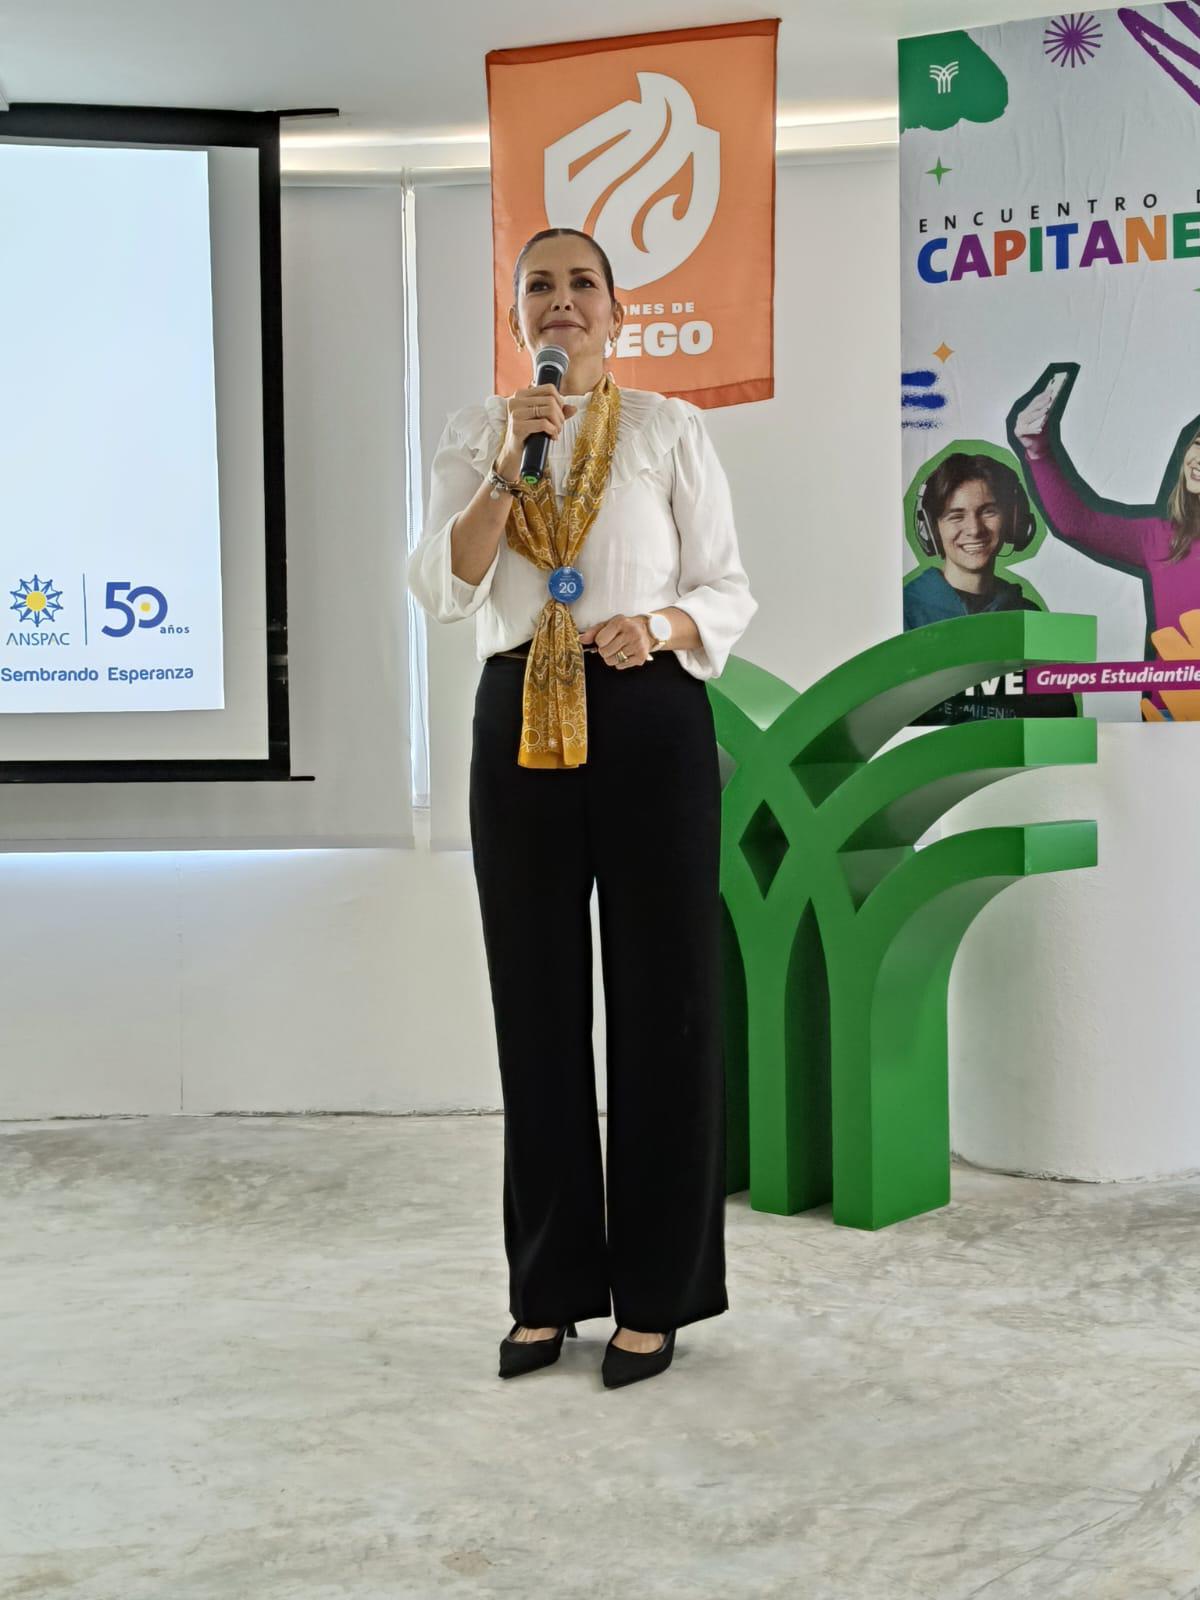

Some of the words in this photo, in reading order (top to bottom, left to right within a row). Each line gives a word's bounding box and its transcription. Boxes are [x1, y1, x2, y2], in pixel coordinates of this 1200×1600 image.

[919, 194, 1157, 233] ENCUENTRO
[917, 211, 1200, 284] CAPITANE
[671, 302, 695, 314] DE
[559, 581, 577, 594] 20
[101, 581, 168, 638] 50
[160, 624, 190, 634] años
[6, 632, 70, 646] ANSPAC
[0, 667, 99, 682] Sembrando
[108, 667, 194, 684] Esperanza
[1037, 670, 1097, 691] Grupos
[1101, 665, 1200, 684] Estudiantile
